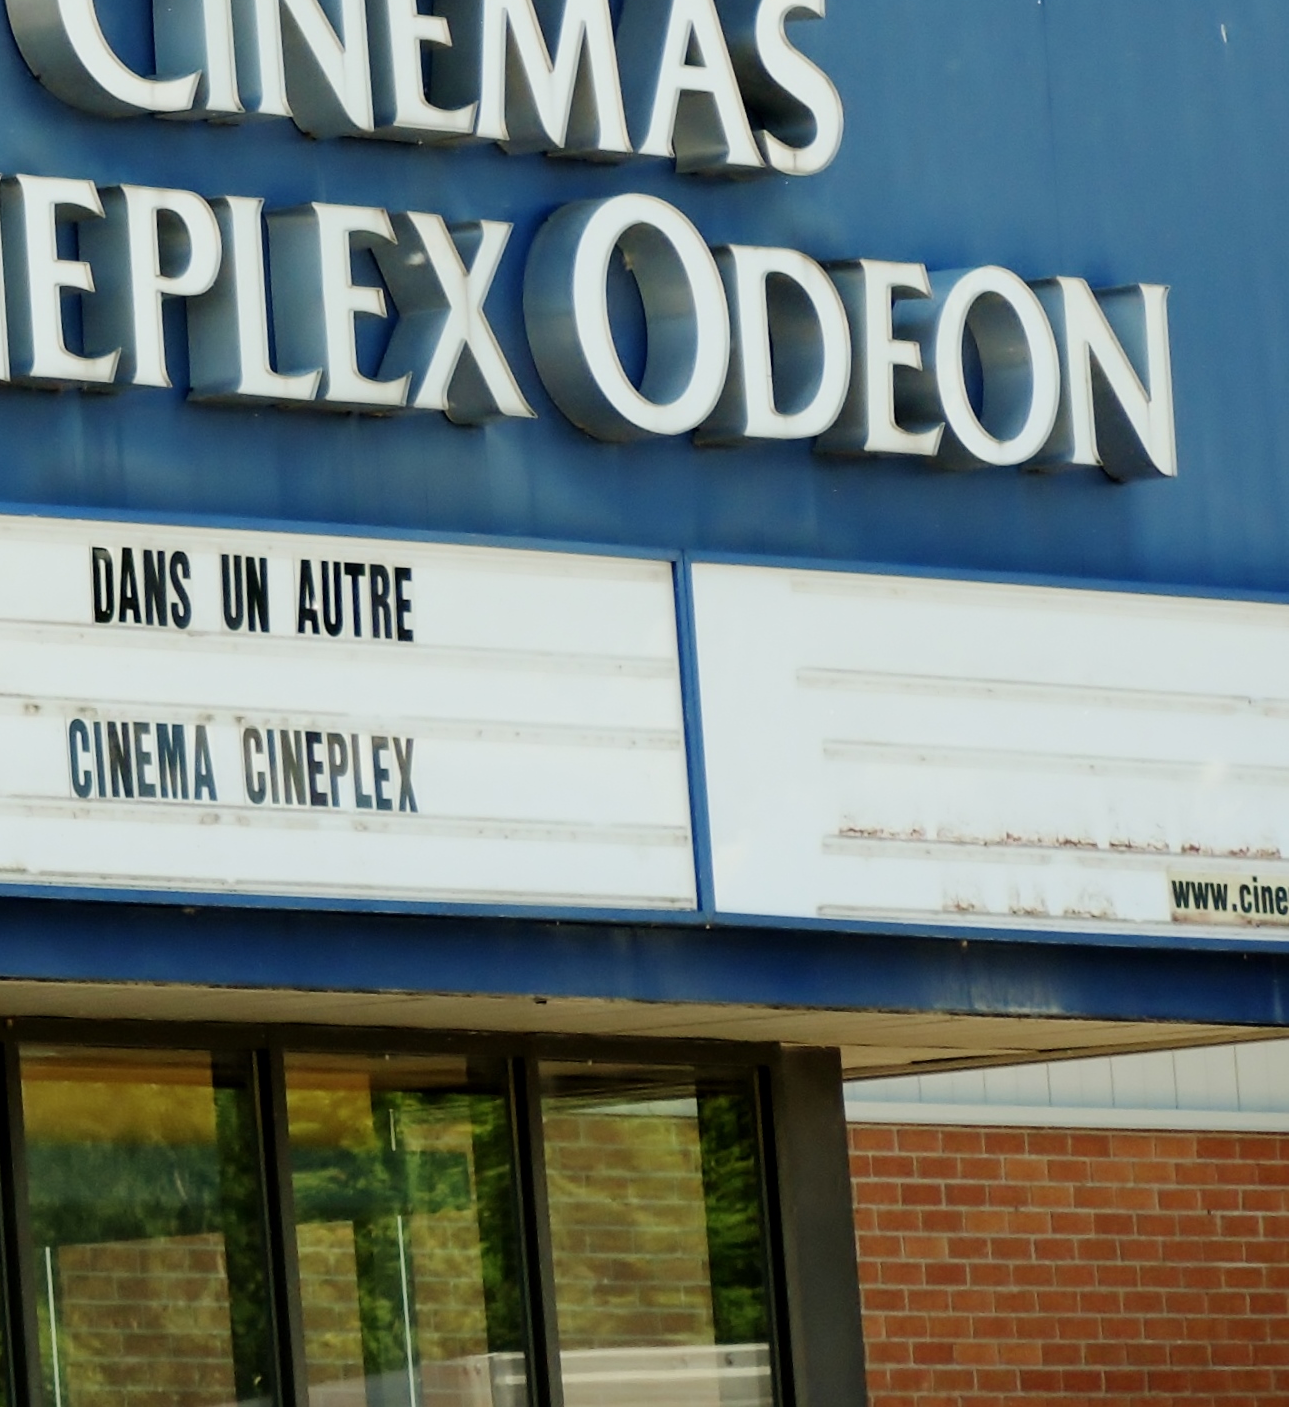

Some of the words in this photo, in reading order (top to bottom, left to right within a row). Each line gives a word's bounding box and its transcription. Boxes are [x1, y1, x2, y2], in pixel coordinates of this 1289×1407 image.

[566, 194, 1178, 481] ODEON
[92, 547, 191, 629] DANS
[221, 554, 269, 633] UN
[298, 559, 413, 642] AUTRE
[69, 719, 216, 800] CINEMA
[243, 728, 417, 812] CINEPLEX
[1171, 876, 1289, 915] www.cine
